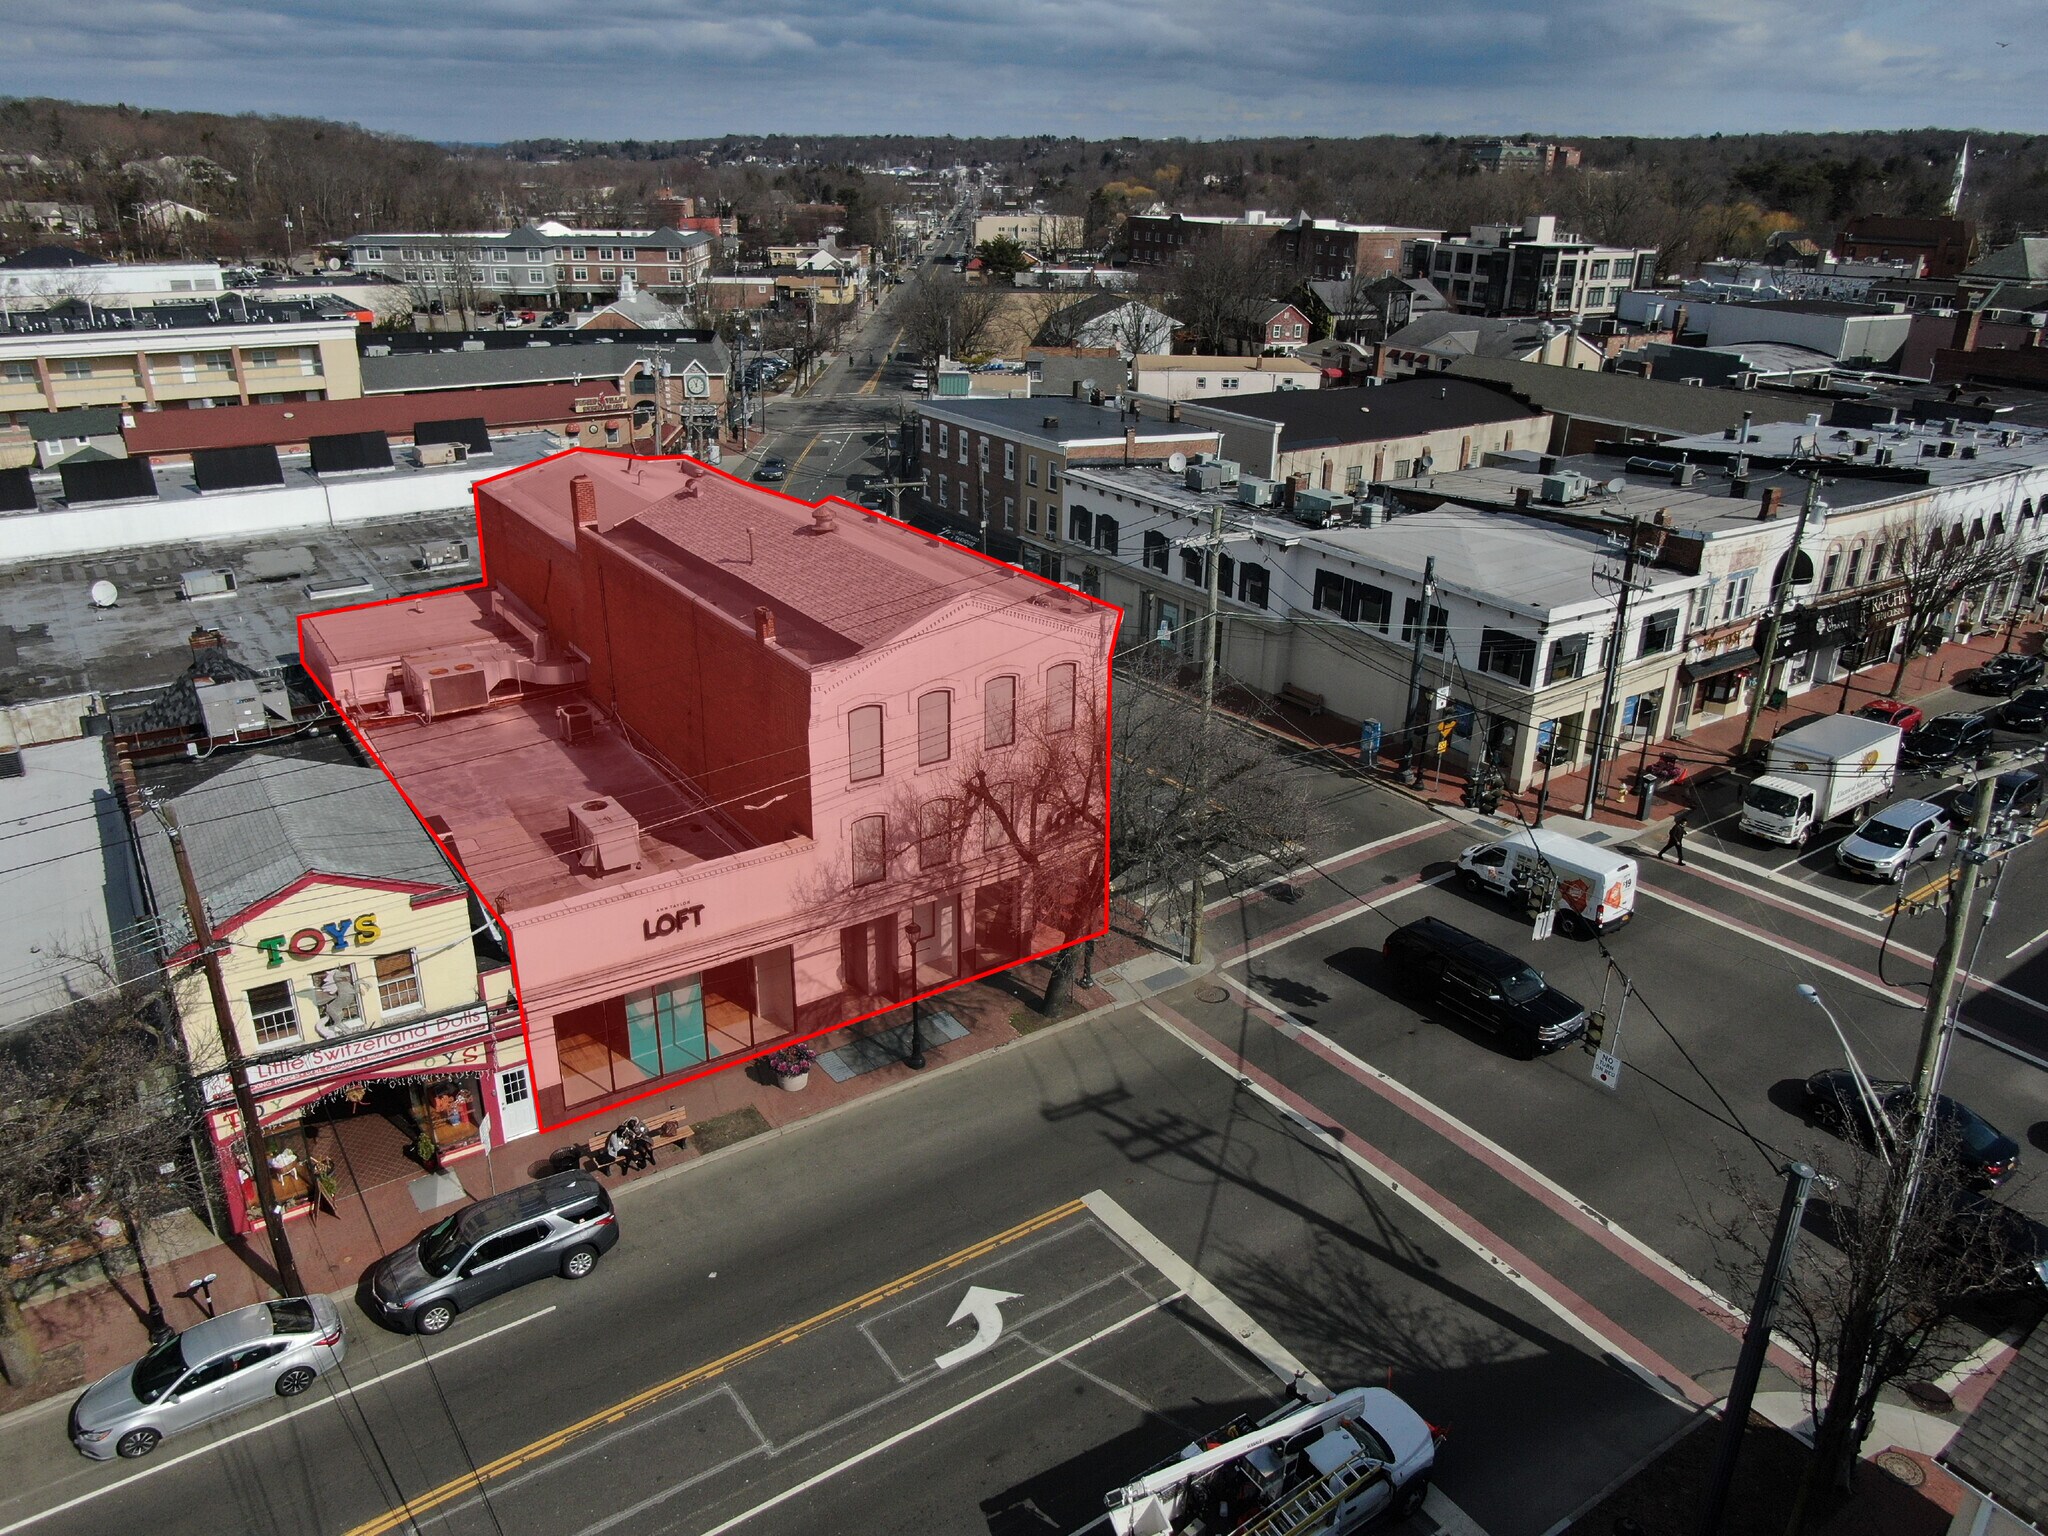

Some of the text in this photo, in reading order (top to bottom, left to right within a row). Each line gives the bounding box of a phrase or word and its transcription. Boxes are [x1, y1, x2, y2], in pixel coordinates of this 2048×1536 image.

[669, 900, 691, 909] TAYLOR
[643, 904, 705, 941] LOFT
[257, 912, 381, 968] TOYS
[257, 1058, 304, 1078] Little
[313, 1023, 427, 1064] Switzerland
[436, 1011, 480, 1032] Dolls
[1602, 1054, 1614, 1064] NO
[1595, 1064, 1603, 1072] ON
[1600, 1060, 1614, 1070] TURN
